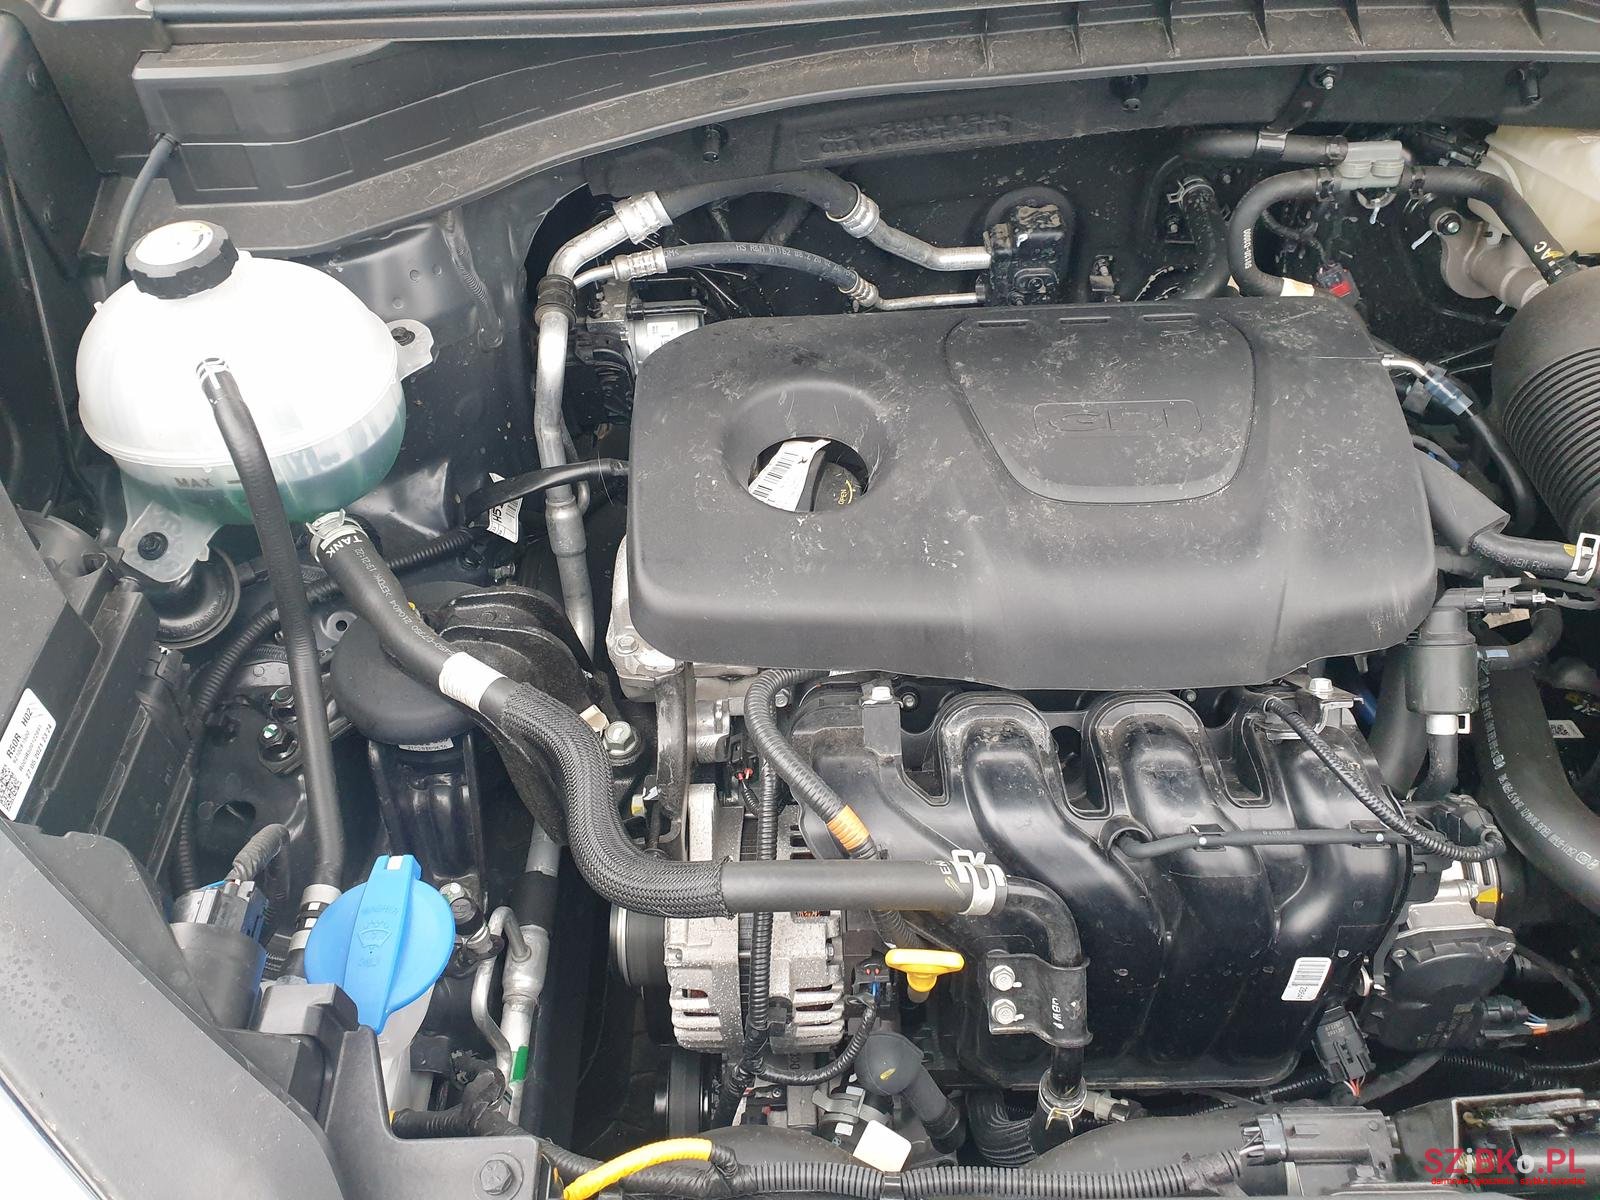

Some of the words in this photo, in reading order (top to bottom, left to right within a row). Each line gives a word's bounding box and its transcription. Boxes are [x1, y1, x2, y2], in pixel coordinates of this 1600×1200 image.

[174, 477, 214, 487] MAX
[837, 490, 847, 504] OPEN
[327, 534, 362, 557] TANK
